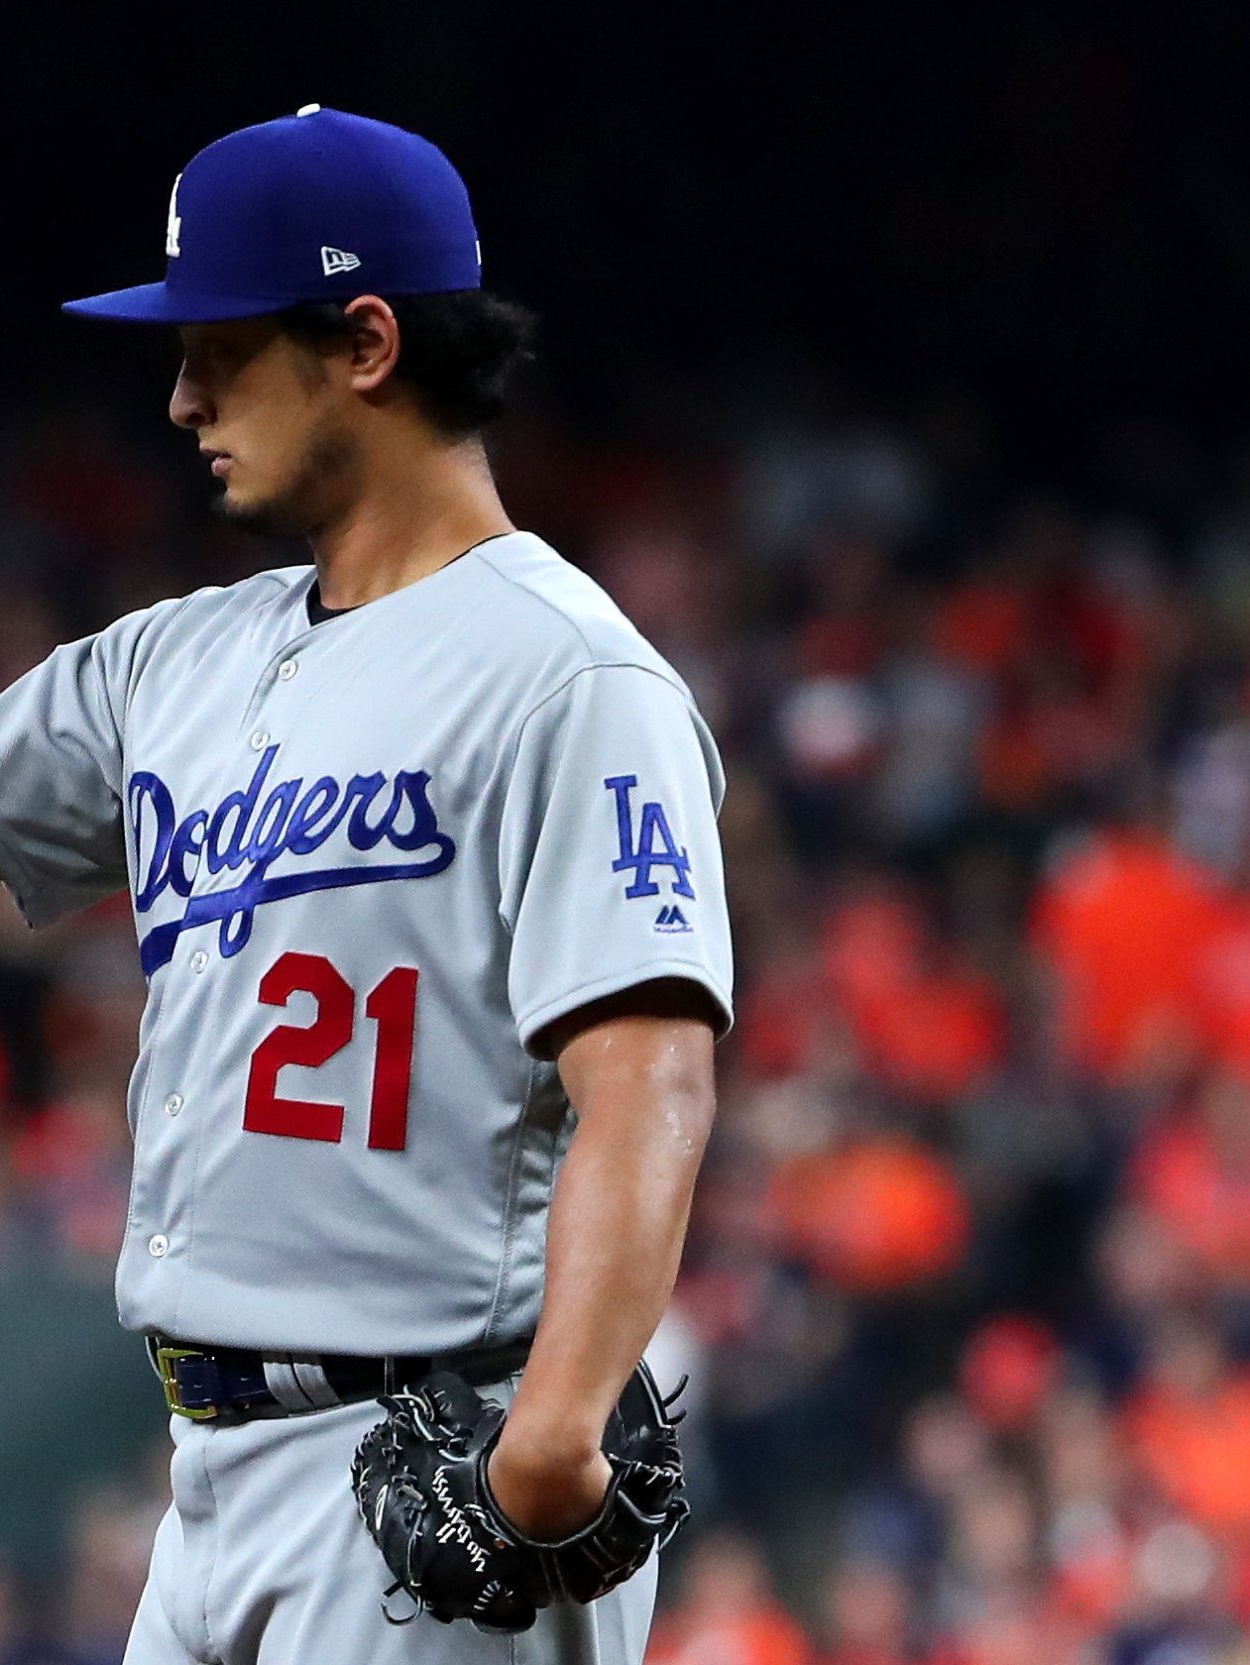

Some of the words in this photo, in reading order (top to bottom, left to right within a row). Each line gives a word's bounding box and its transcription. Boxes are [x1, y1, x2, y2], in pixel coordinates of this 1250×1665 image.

[128, 744, 457, 960] Dodgers
[604, 774, 696, 901] LA
[243, 951, 420, 1151] 21
